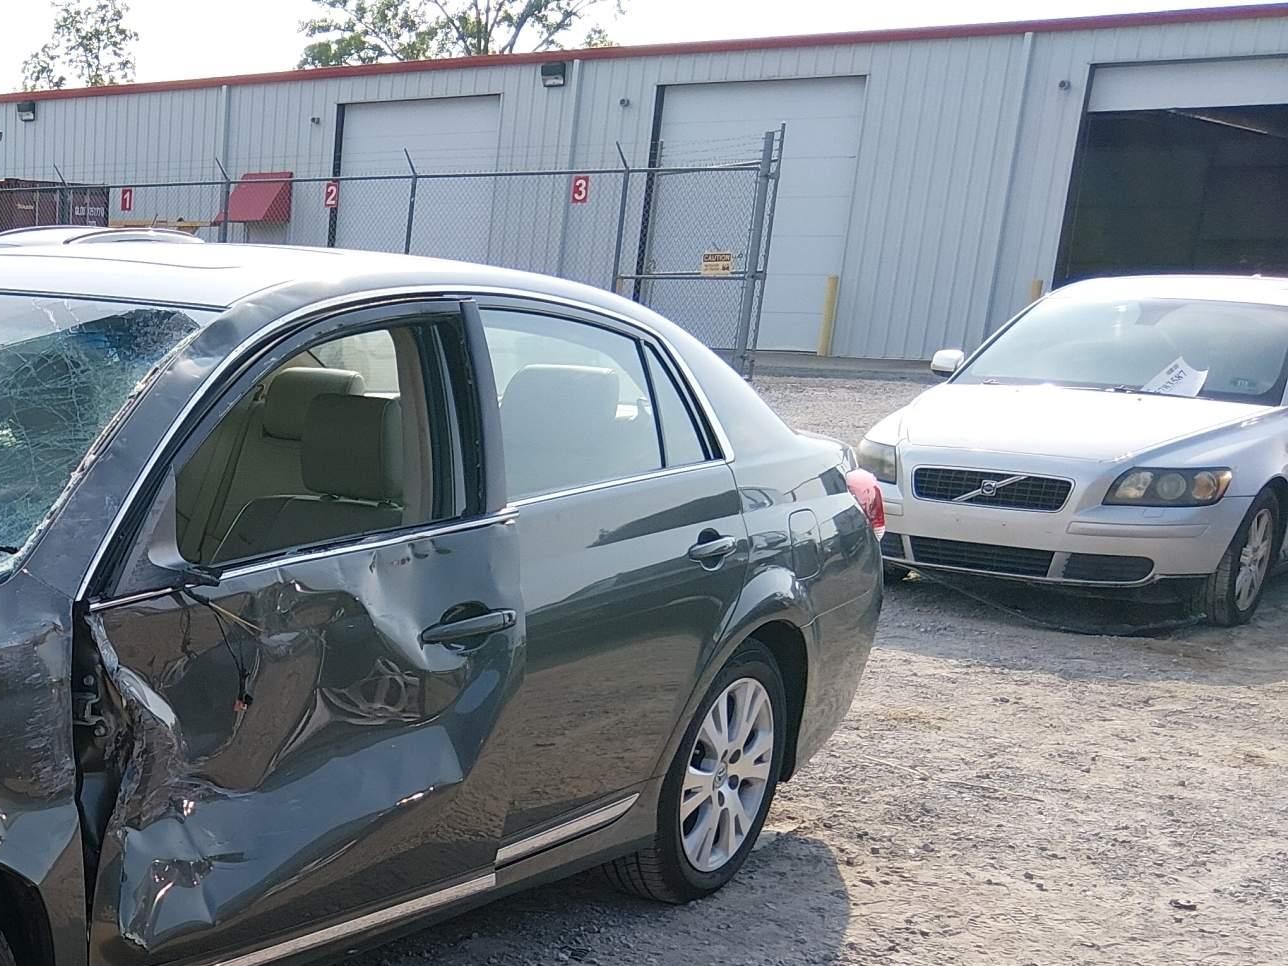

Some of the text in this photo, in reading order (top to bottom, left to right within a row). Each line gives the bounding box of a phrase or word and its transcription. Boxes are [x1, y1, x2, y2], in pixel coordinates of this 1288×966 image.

[326, 186, 337, 206] 2
[574, 179, 587, 200] 3
[123, 191, 131, 209] 1
[703, 254, 731, 262] CAUTION
